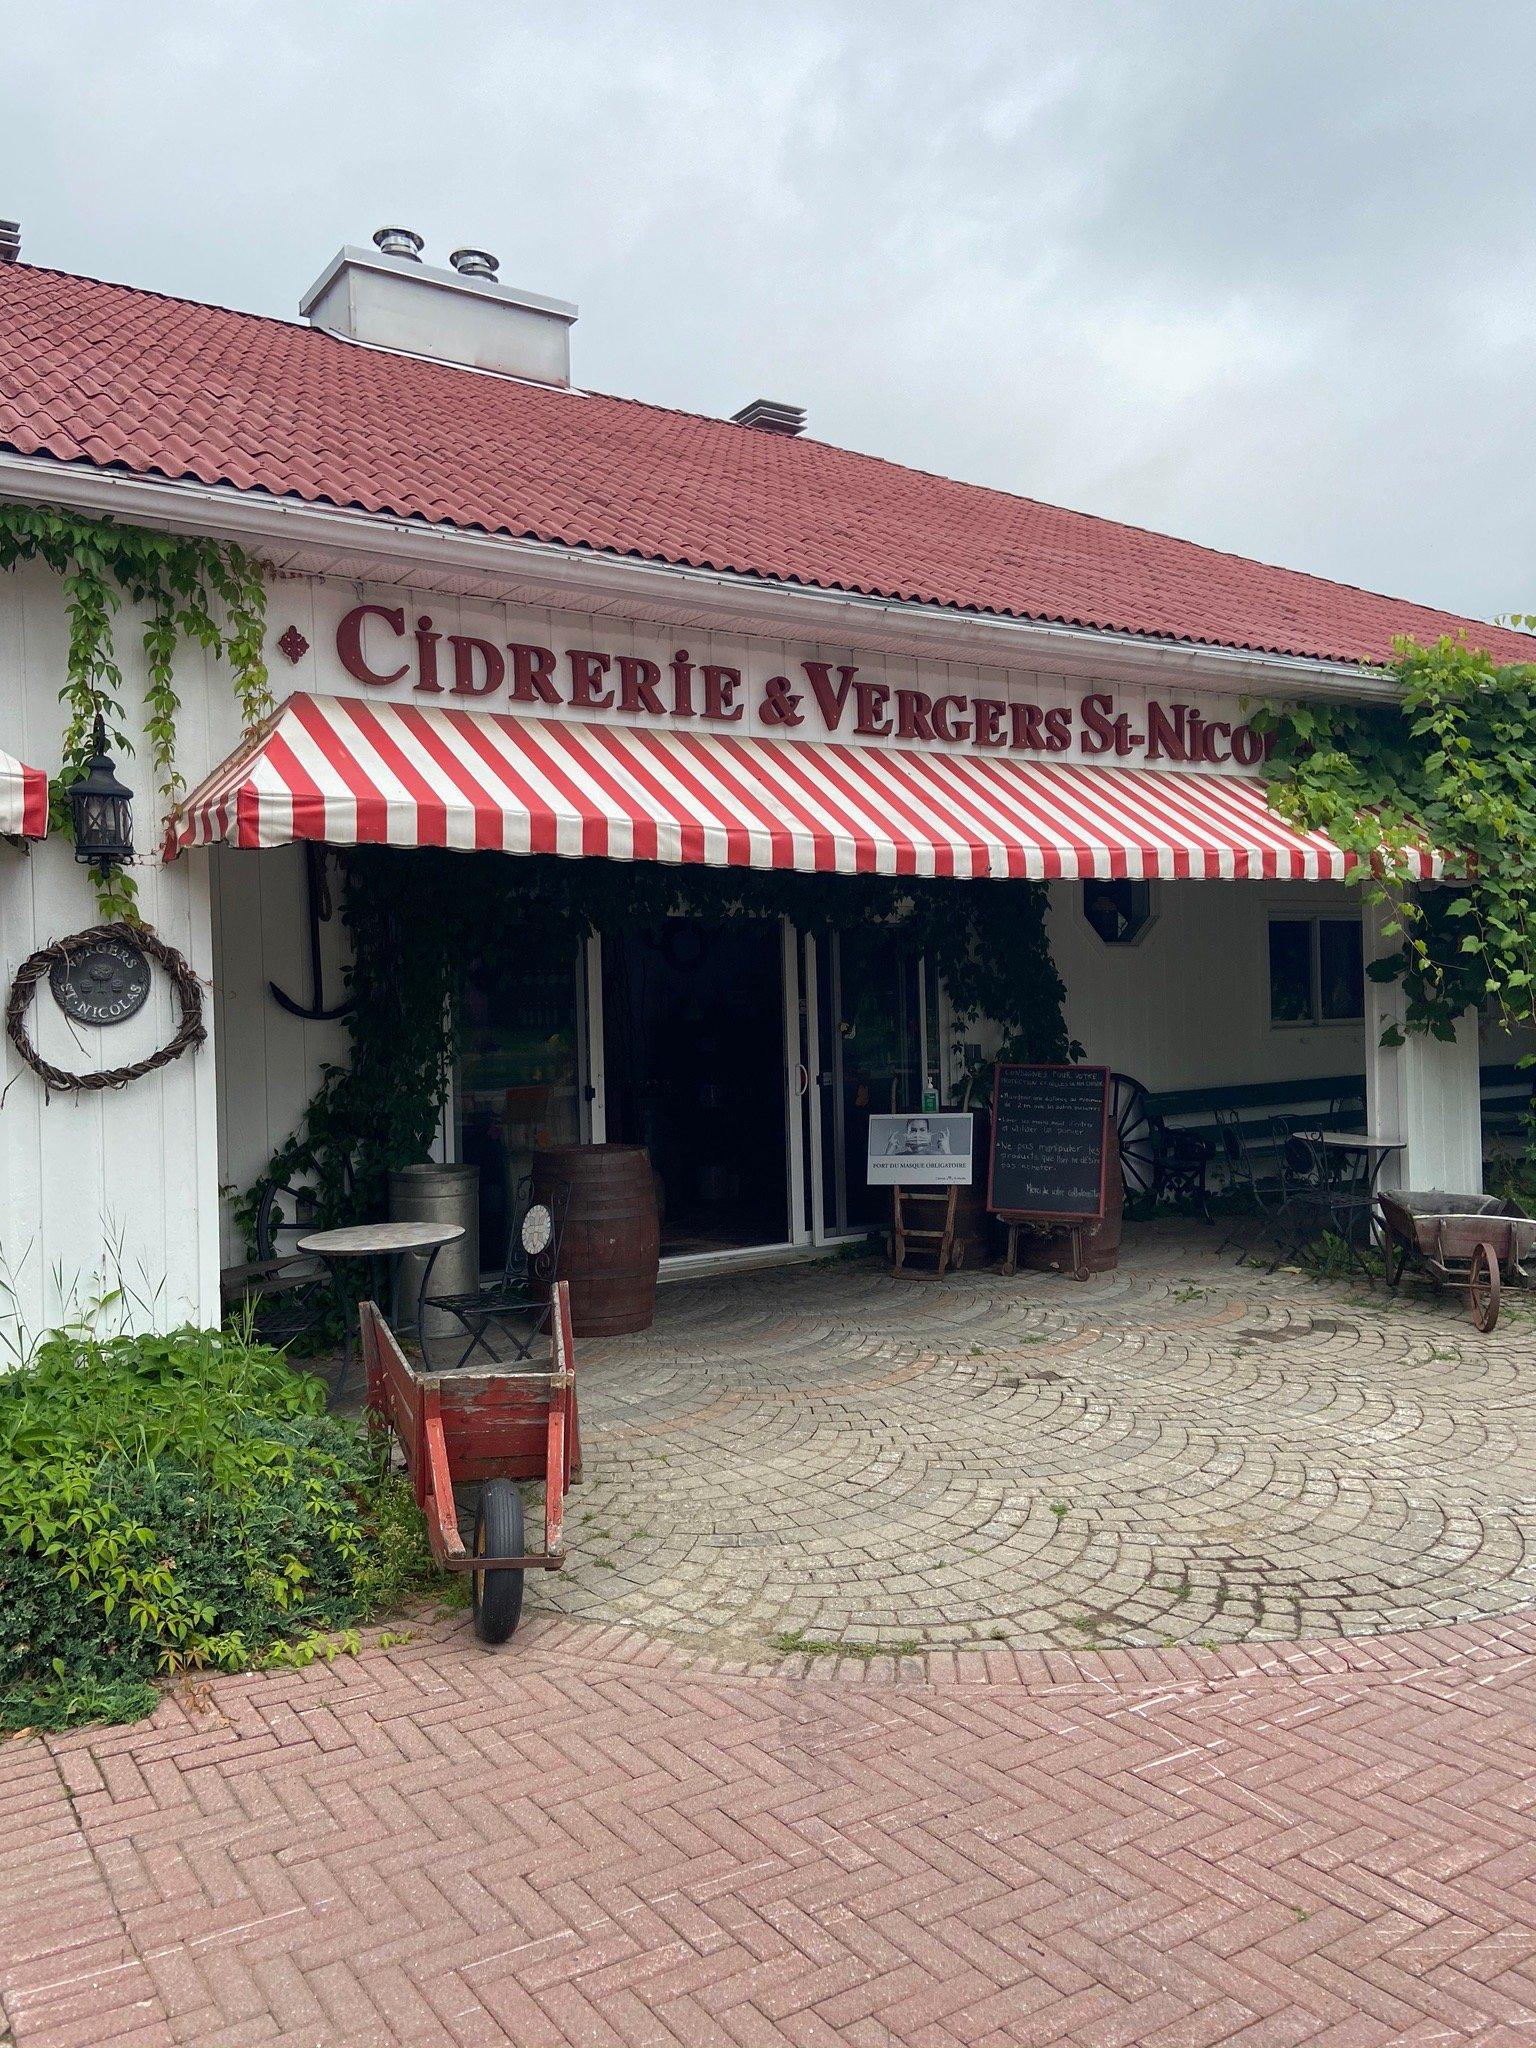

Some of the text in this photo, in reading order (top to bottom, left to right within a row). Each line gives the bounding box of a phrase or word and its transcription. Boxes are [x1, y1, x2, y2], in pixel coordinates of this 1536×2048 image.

[759, 676, 804, 727] &
[801, 661, 1072, 752] VERGERS
[1081, 693, 1280, 766] St-Nico
